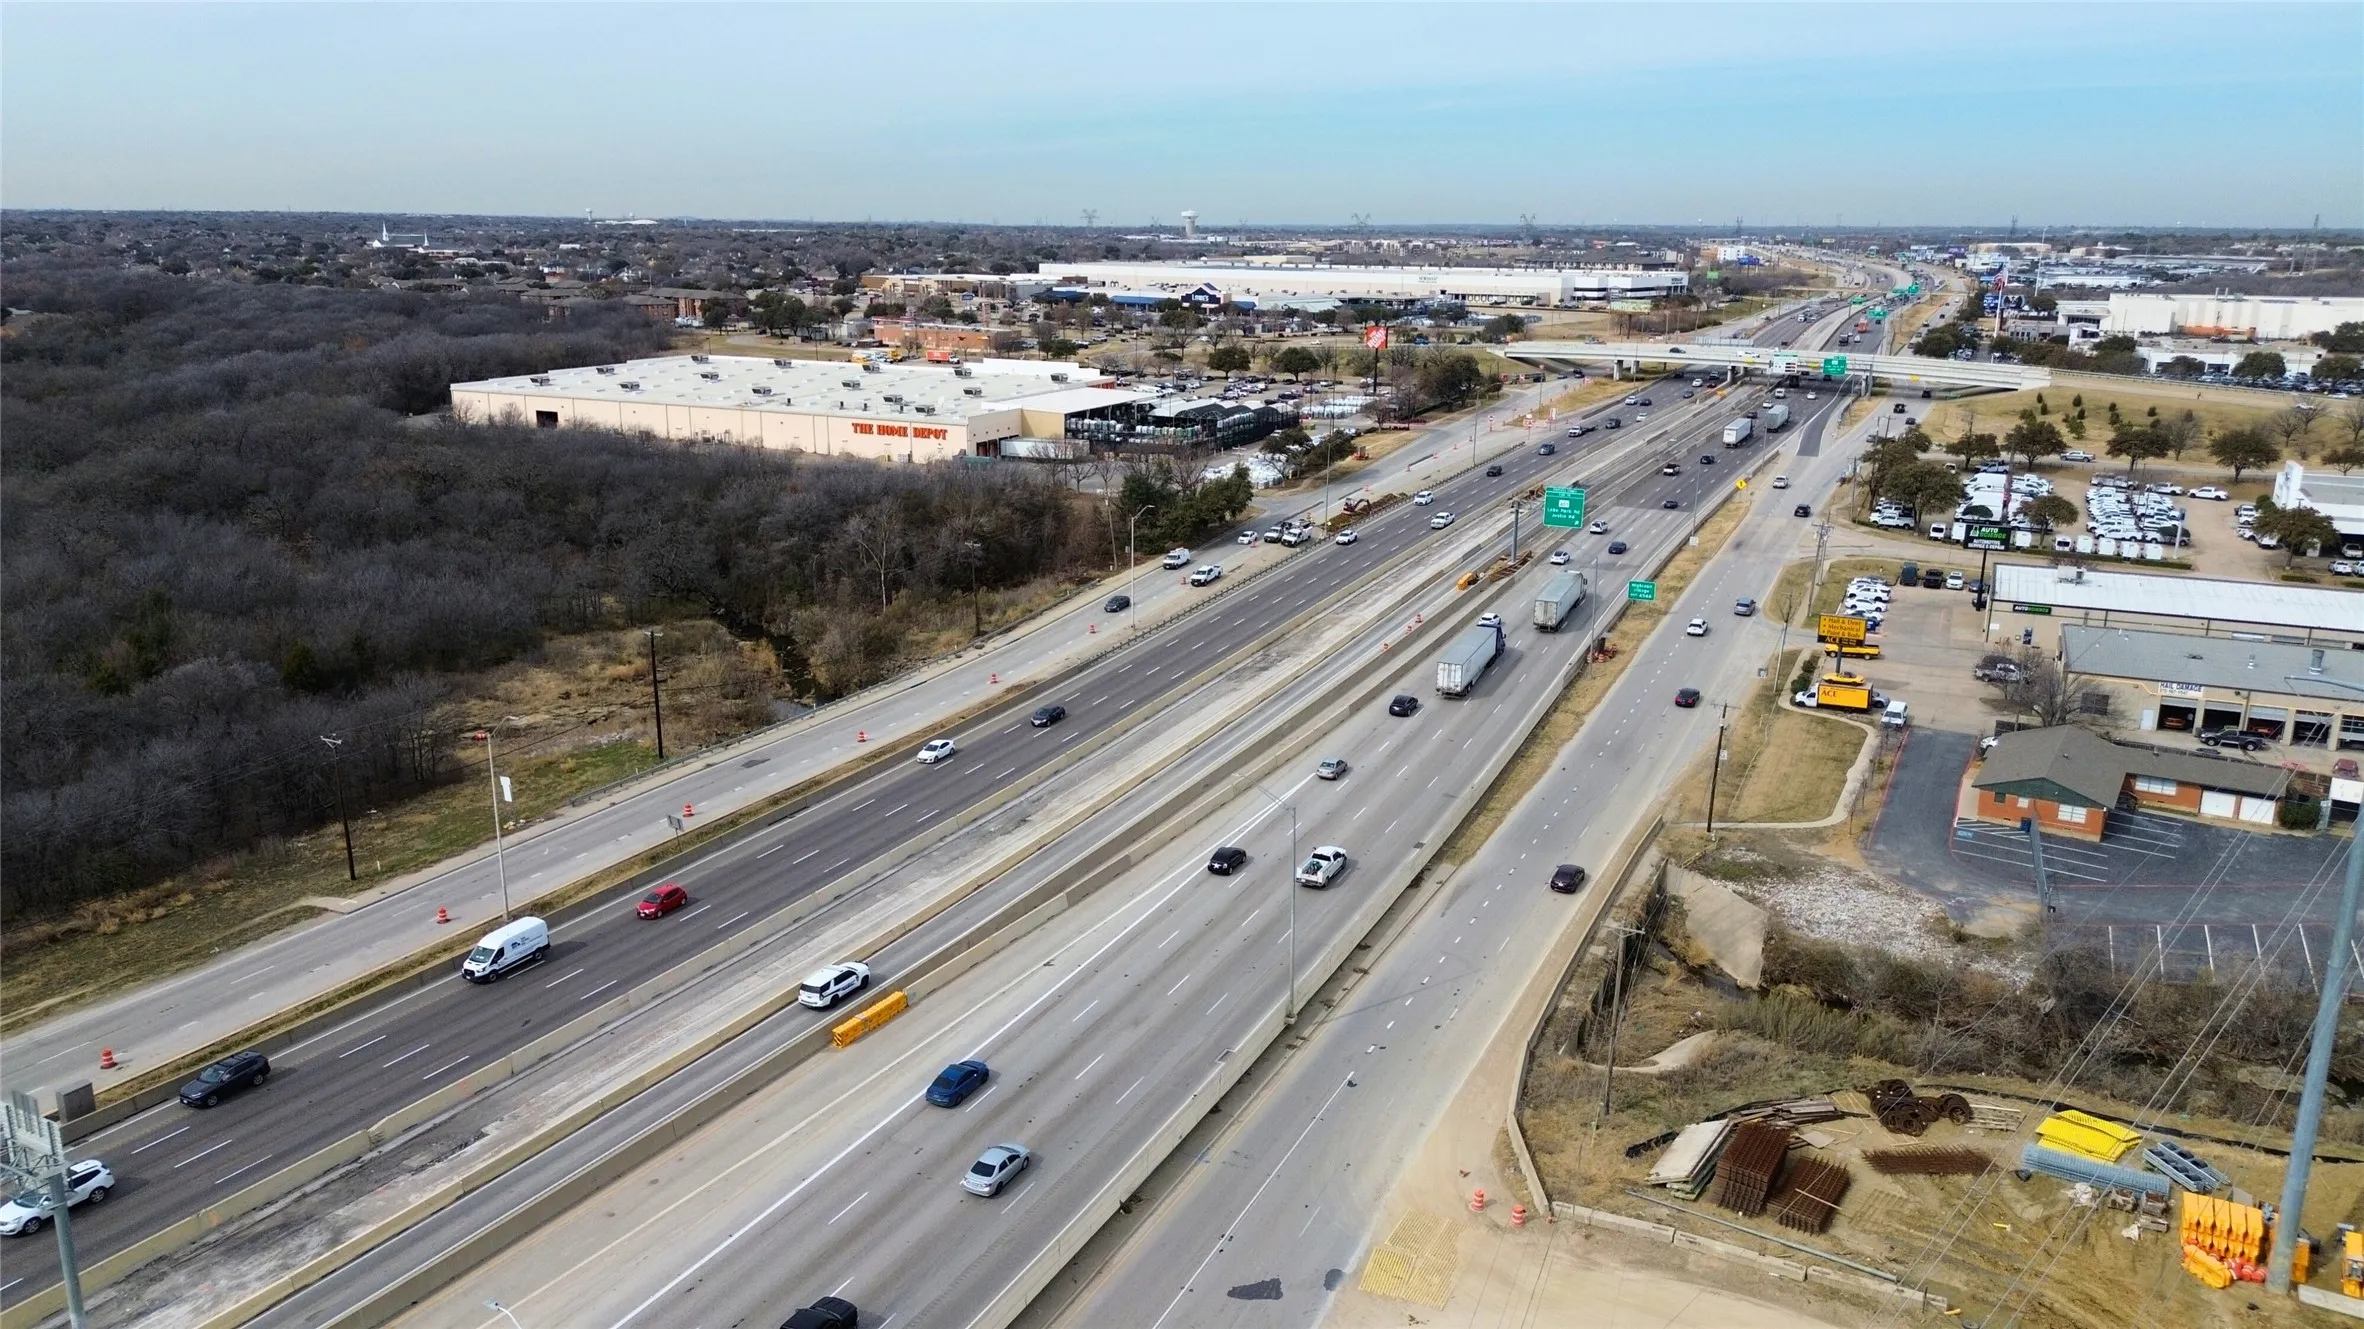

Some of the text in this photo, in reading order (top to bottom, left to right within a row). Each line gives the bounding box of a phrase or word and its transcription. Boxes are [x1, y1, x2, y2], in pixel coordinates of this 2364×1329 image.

[852, 422, 948, 440] THE HOME DEPOT
[1828, 623, 1861, 632] Mechanical
[1847, 631, 1861, 639] Body
[1825, 636, 1840, 644] ACE
[2160, 681, 2173, 689] HAIL
[2176, 683, 2202, 692] DAMAGE
